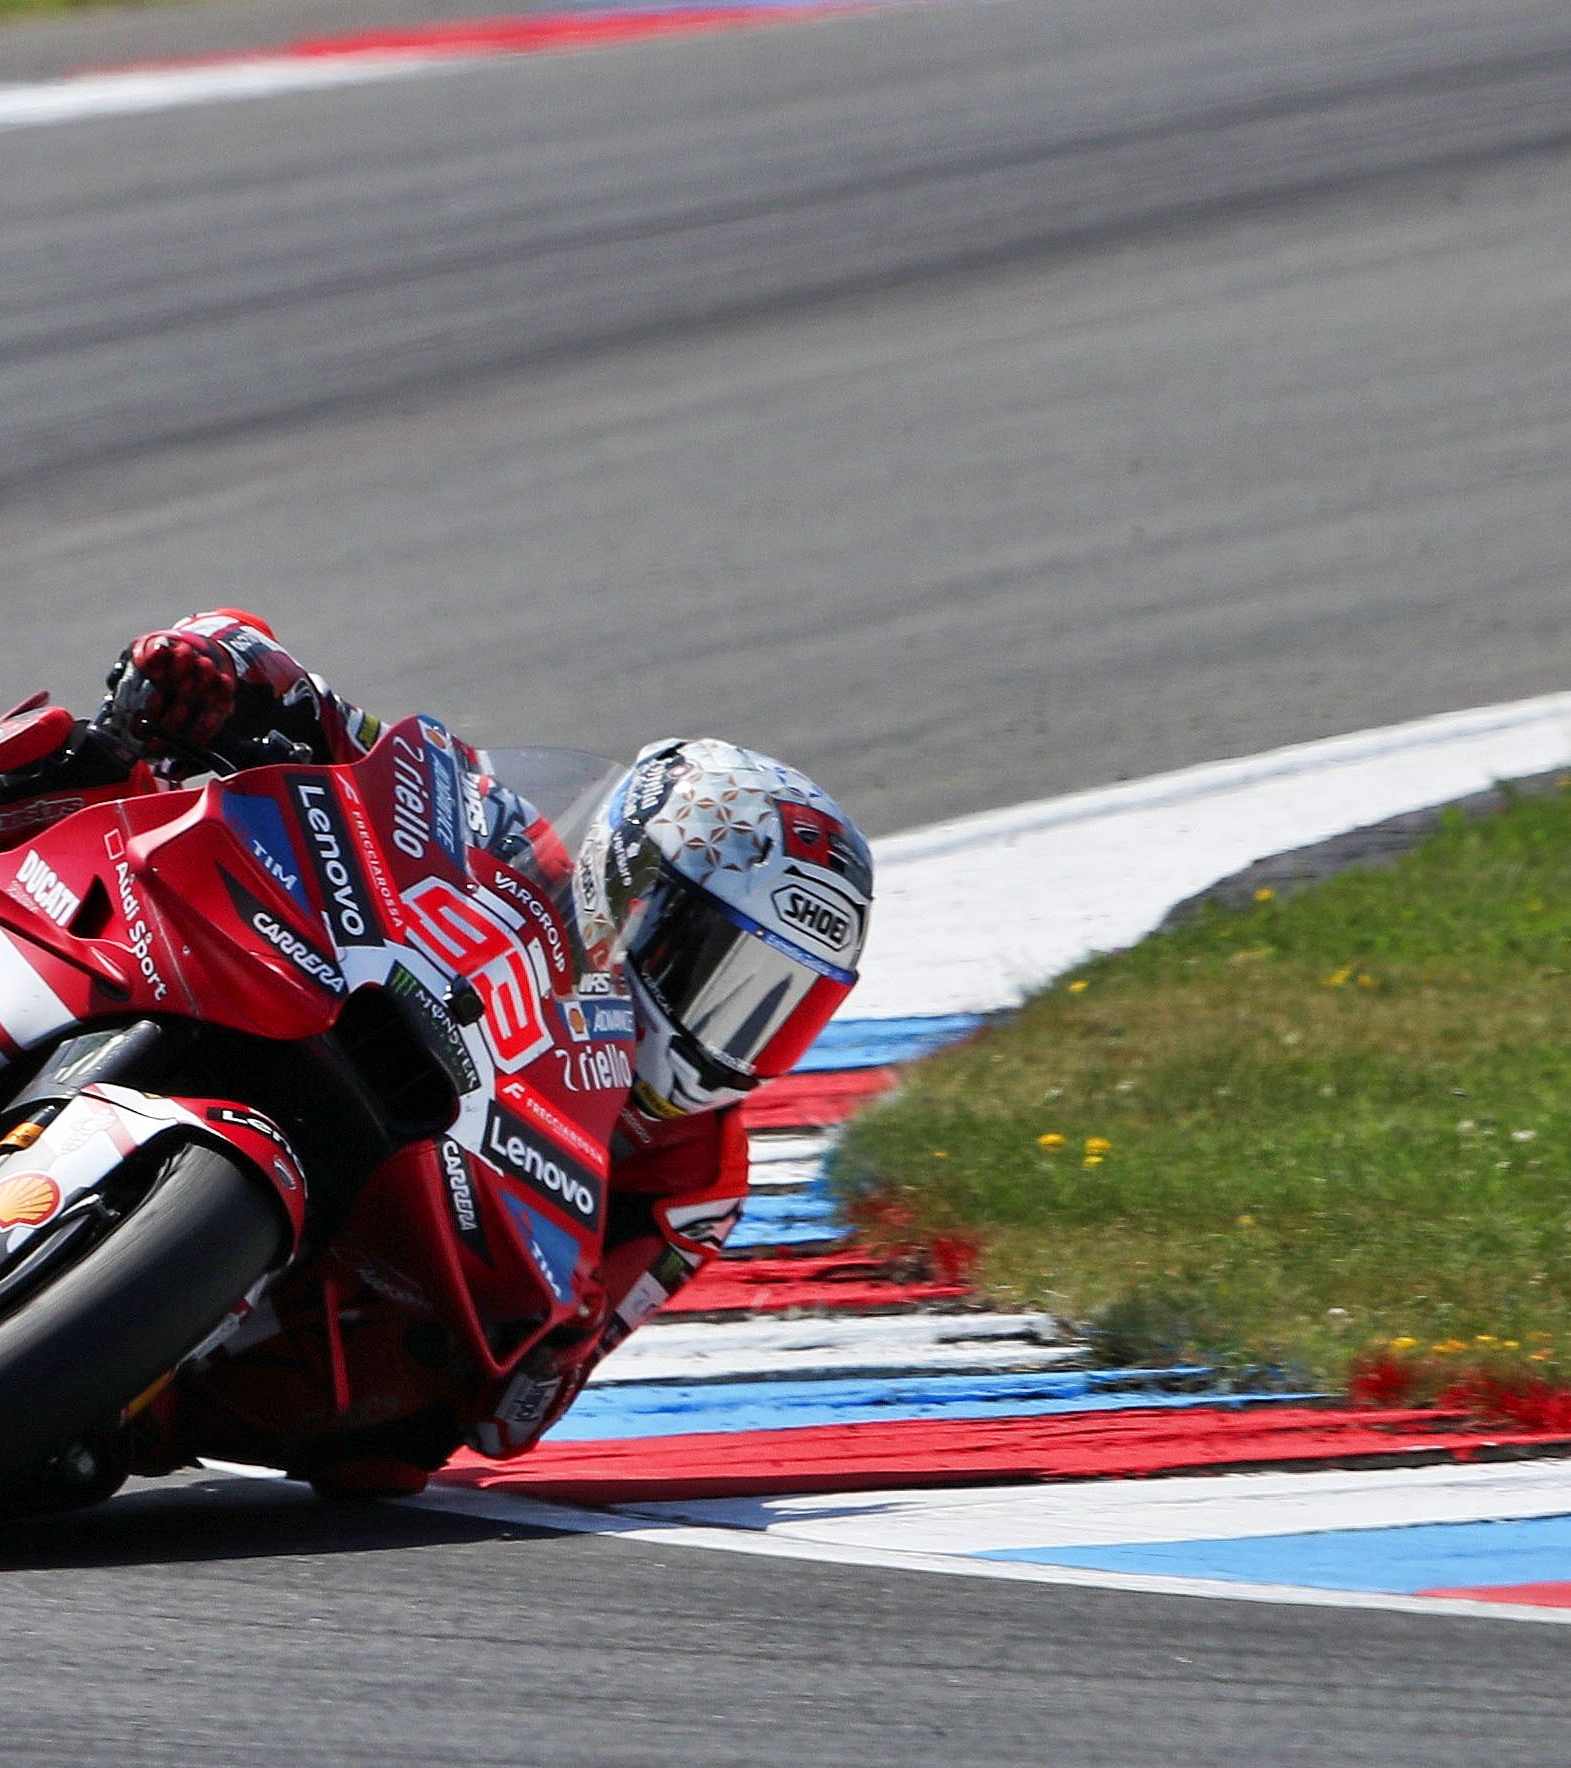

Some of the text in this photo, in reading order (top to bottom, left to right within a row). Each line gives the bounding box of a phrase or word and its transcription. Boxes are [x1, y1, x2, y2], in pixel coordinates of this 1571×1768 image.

[16, 848, 81, 927] DUCATI
[253, 839, 298, 891] TIM
[297, 784, 366, 936] Lenovo
[352, 810, 404, 927] FRECCIAROSSA
[115, 861, 168, 1001] Audi Sport
[252, 911, 346, 993] CARRERA
[494, 870, 566, 973] VARGROUP
[402, 880, 548, 1066] 93
[442, 1140, 478, 1231] CARRERA
[490, 1115, 594, 1215] Lenovo
